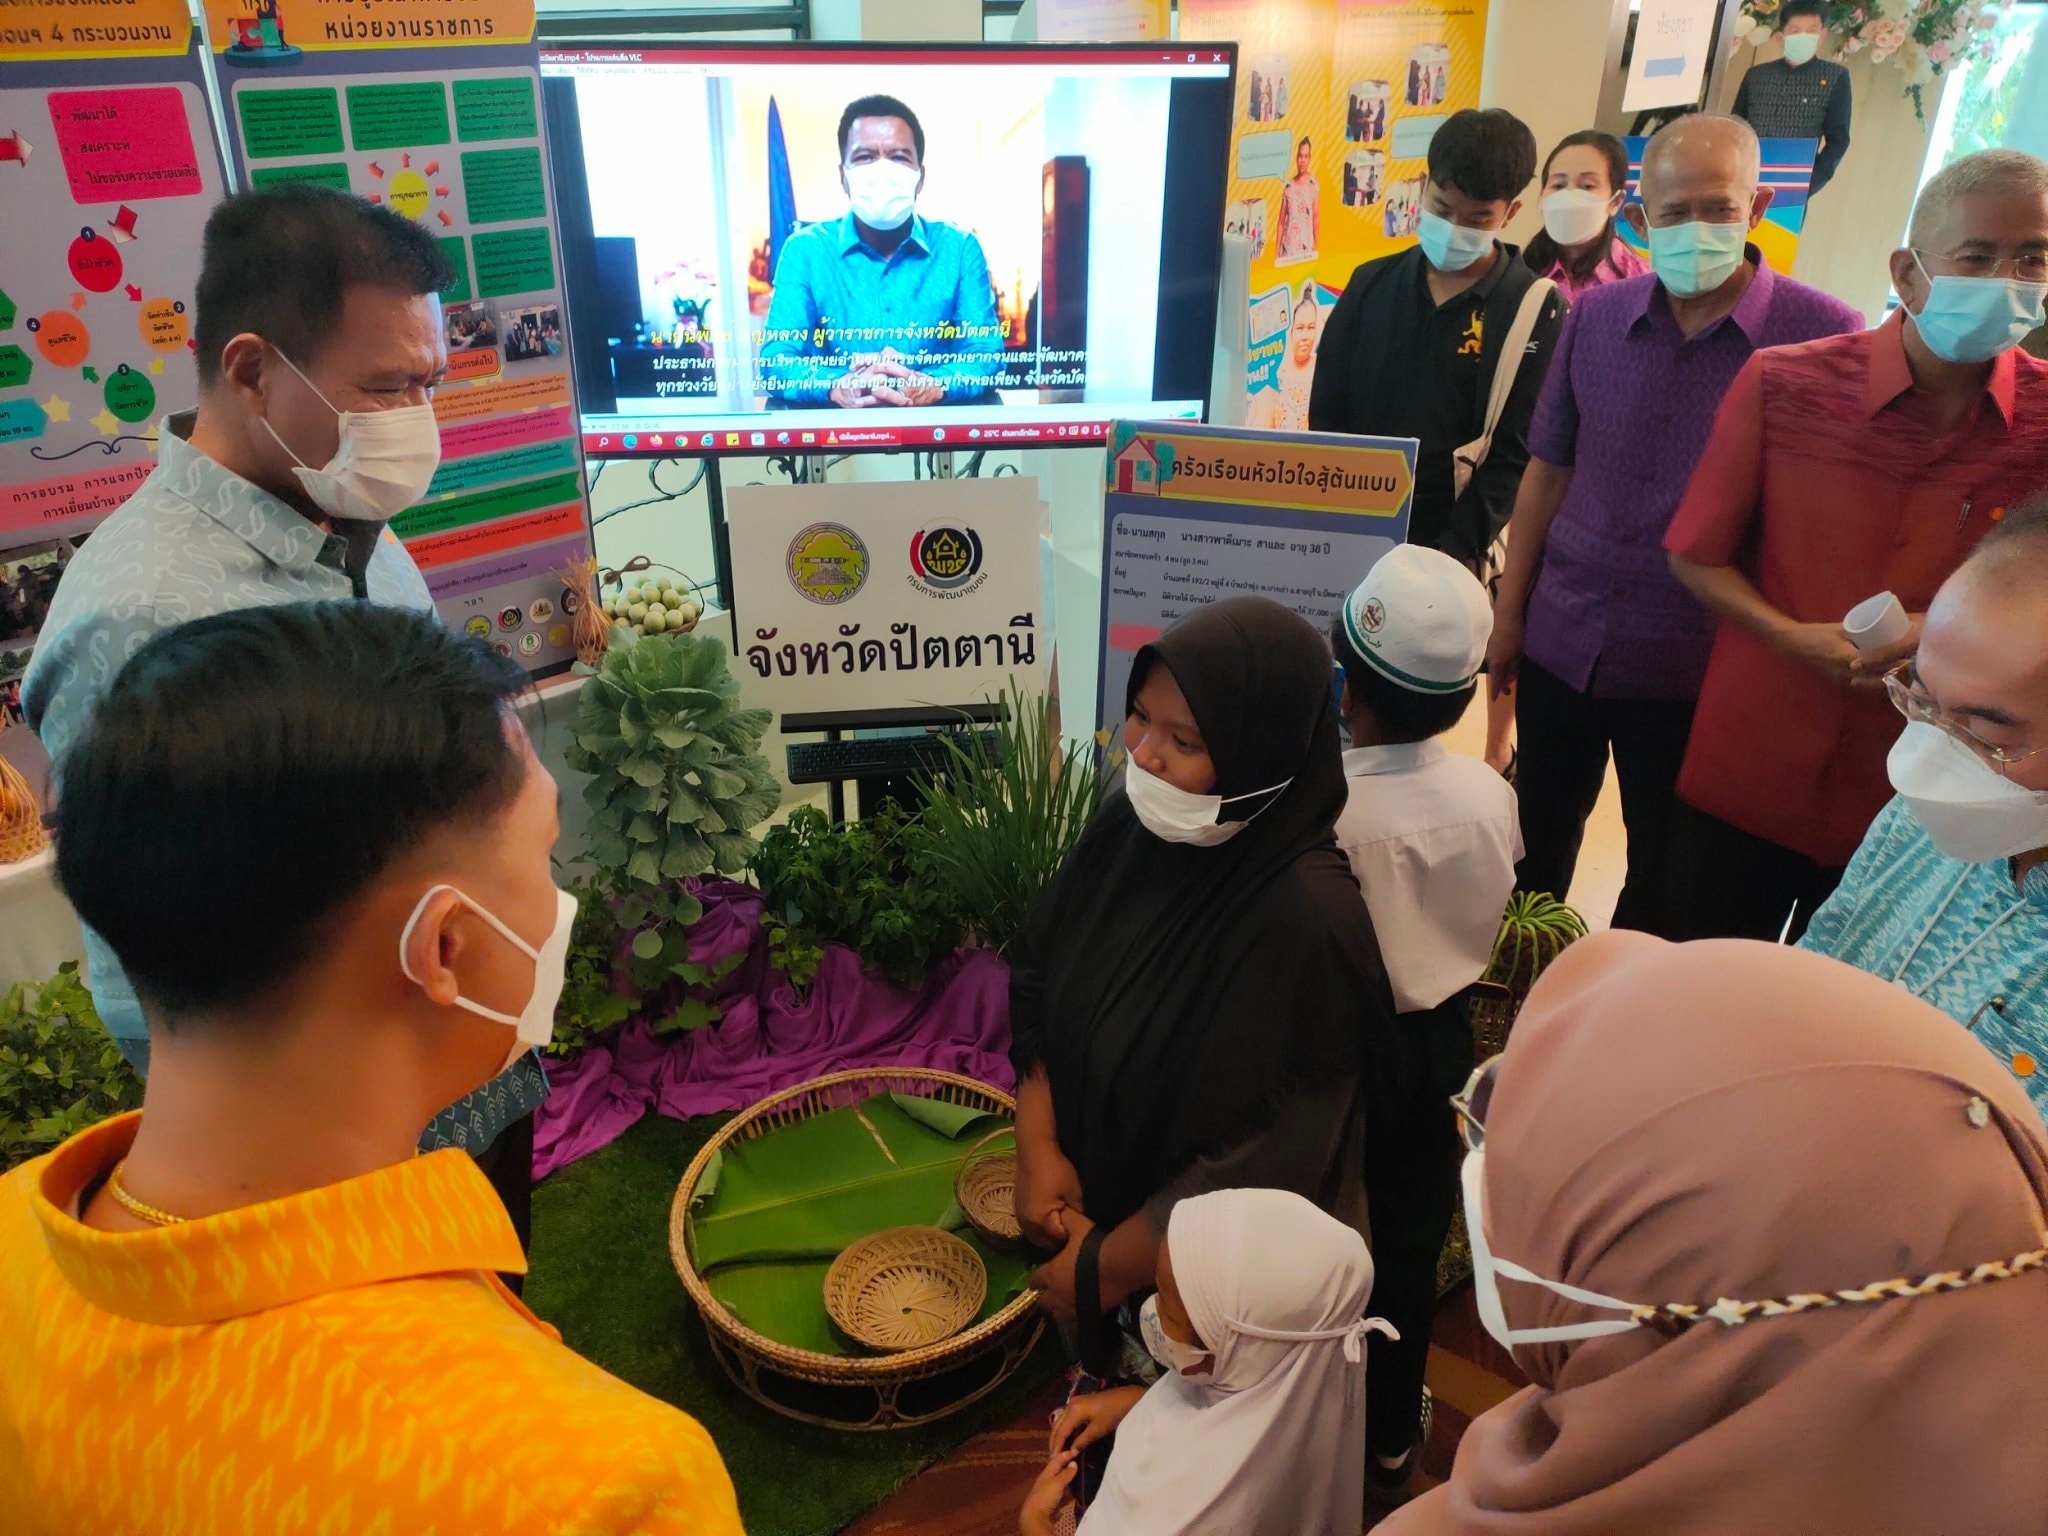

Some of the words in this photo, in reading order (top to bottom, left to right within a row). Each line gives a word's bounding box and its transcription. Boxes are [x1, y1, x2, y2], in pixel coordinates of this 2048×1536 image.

[0, 27, 42, 44] จนฯ
[51, 24, 64, 42] 4
[72, 24, 172, 42] กระบวนงาน
[325, 14, 494, 40] หน่วยงานราชการ
[629, 53, 642, 62] VLC
[72, 105, 118, 121] พัฒนาได้
[813, 317, 1011, 347] ผู้ว่าราชการจังหวัดปัตตานี
[1172, 459, 1397, 494] ครัวเรือนหัวไวใจสู้ต้นแบบ
[13, 483, 74, 503] การอบรม
[43, 495, 116, 518] การเยี่ยมบ้าน
[1116, 520, 1166, 543] ชื่อ-นามสกุล
[1290, 543, 1307, 556] อายุ
[1323, 542, 1331, 555] ปี
[906, 571, 989, 600] กรมการพัฒนาชุมชน
[746, 612, 1036, 678] จังหวัดปัตตานี
